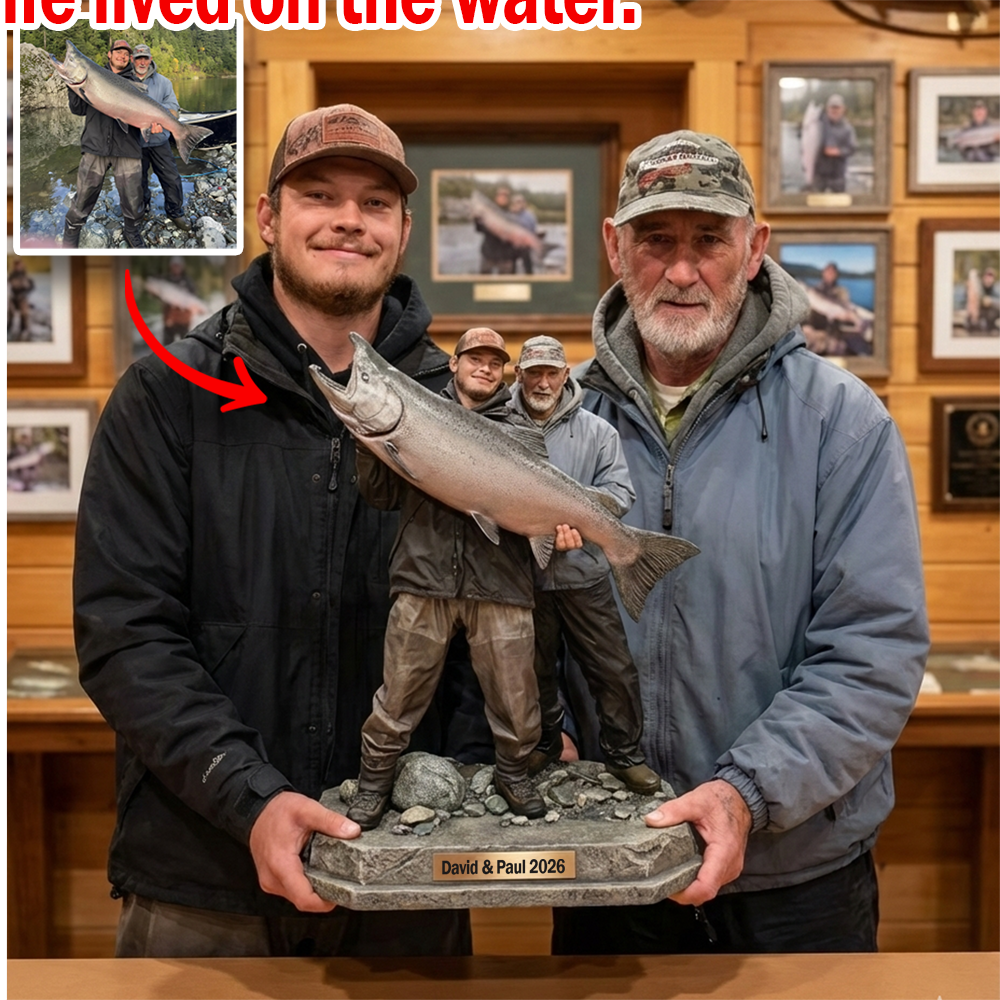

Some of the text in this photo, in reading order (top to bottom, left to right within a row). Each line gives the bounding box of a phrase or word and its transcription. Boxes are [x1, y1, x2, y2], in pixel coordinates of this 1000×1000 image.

[441, 858, 566, 875] David & Paul 2026
